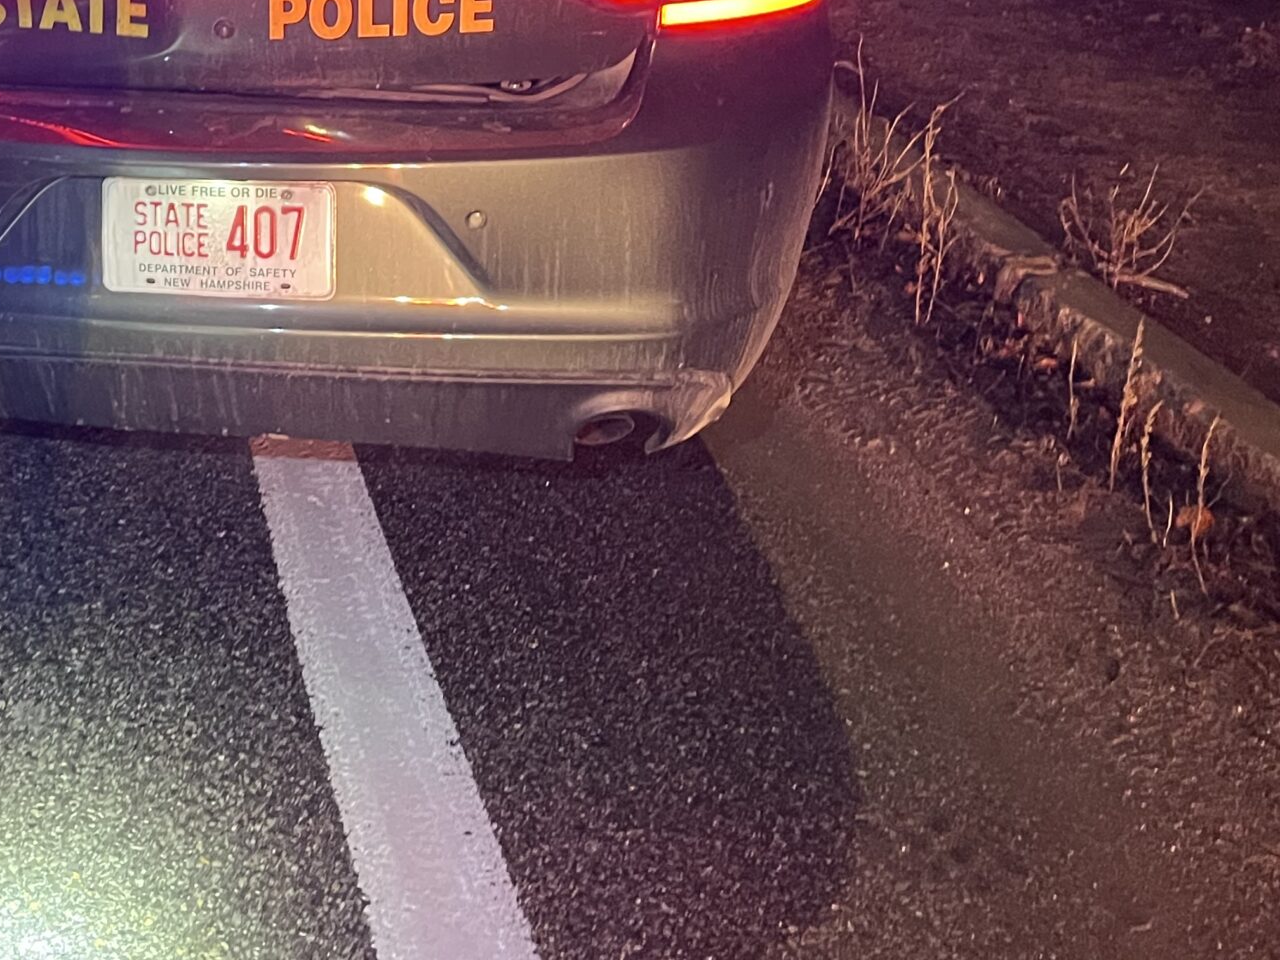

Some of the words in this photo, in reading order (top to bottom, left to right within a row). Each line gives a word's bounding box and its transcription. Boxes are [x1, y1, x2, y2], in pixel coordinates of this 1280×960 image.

[158, 185, 186, 196] LIVE
[192, 186, 225, 197] FREE
[231, 187, 250, 198] OR
[255, 188, 277, 198] DIE
[134, 201, 208, 229] STATE
[226, 205, 305, 260] 407
[134, 231, 209, 257] POLICE
[139, 263, 217, 276] DEPARTMENT
[226, 267, 241, 276] OF
[250, 268, 296, 278] SAFETY
[164, 278, 190, 287] NEW
[201, 279, 270, 290] HAMPSHIRE
